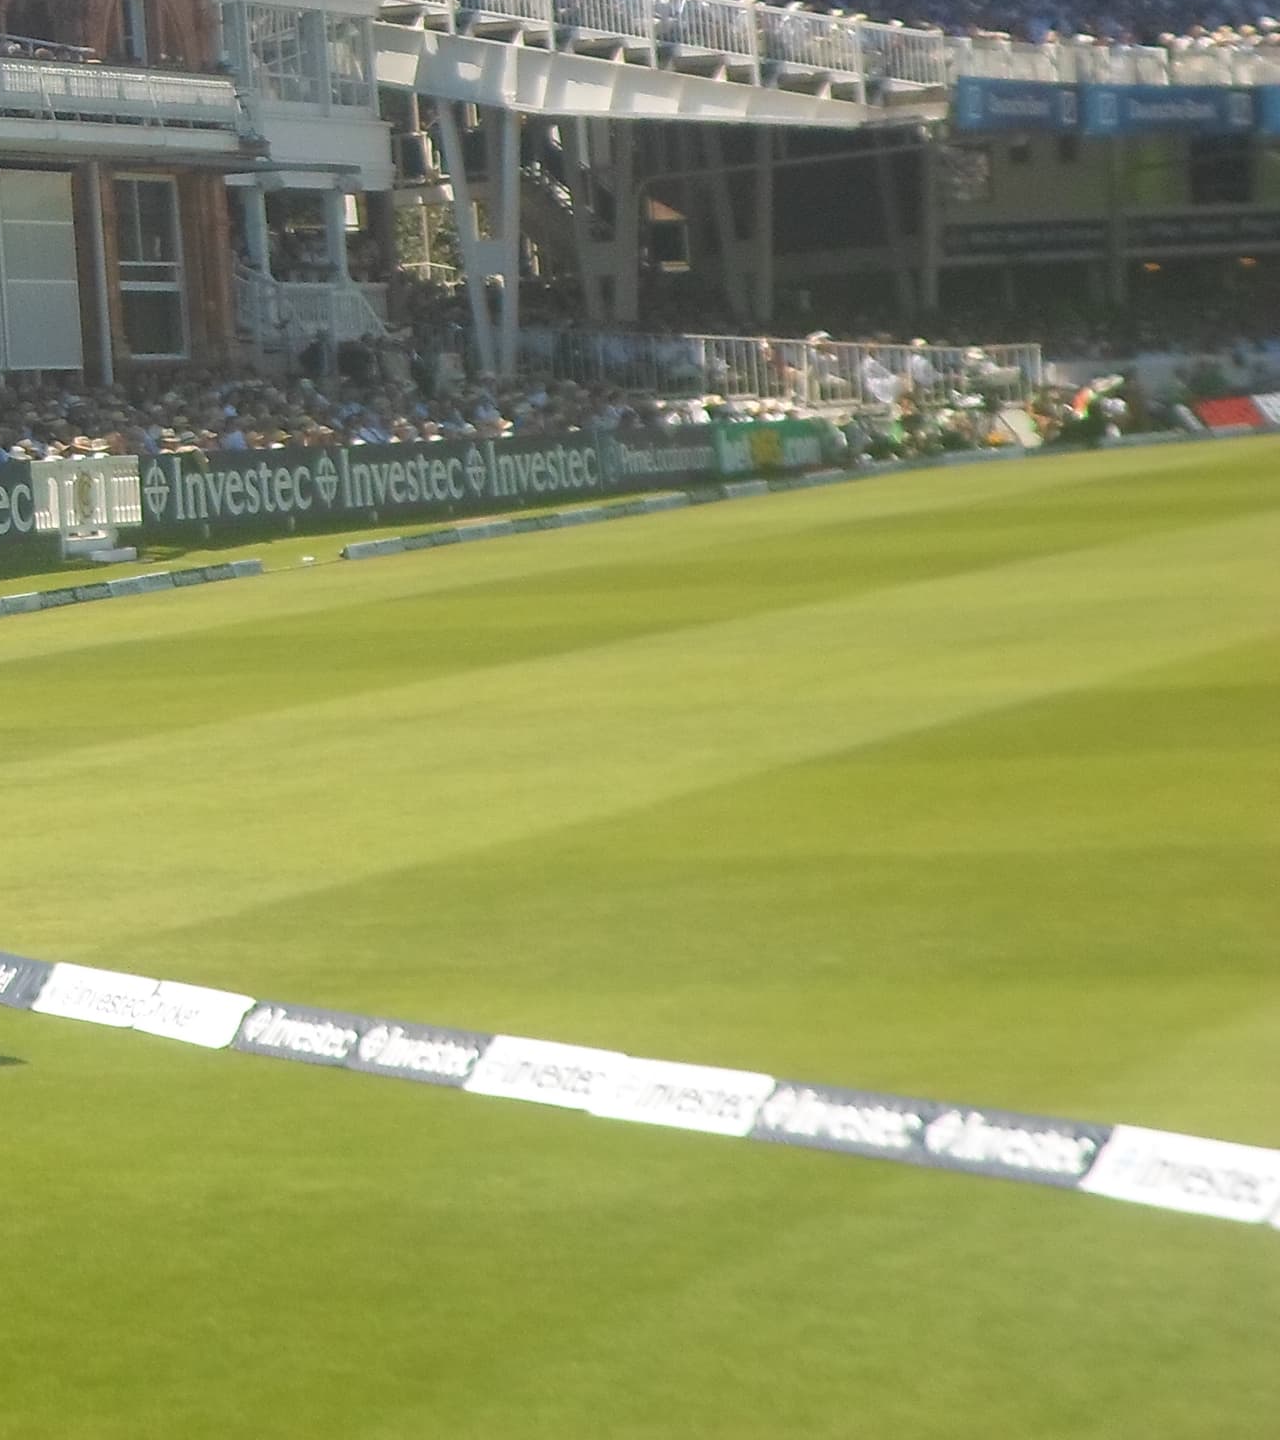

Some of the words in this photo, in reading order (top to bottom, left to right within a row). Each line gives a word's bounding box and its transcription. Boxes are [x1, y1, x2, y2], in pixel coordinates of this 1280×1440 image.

[173, 457, 312, 520] Investec
[341, 448, 464, 507] Investec
[487, 440, 598, 496] Investec
